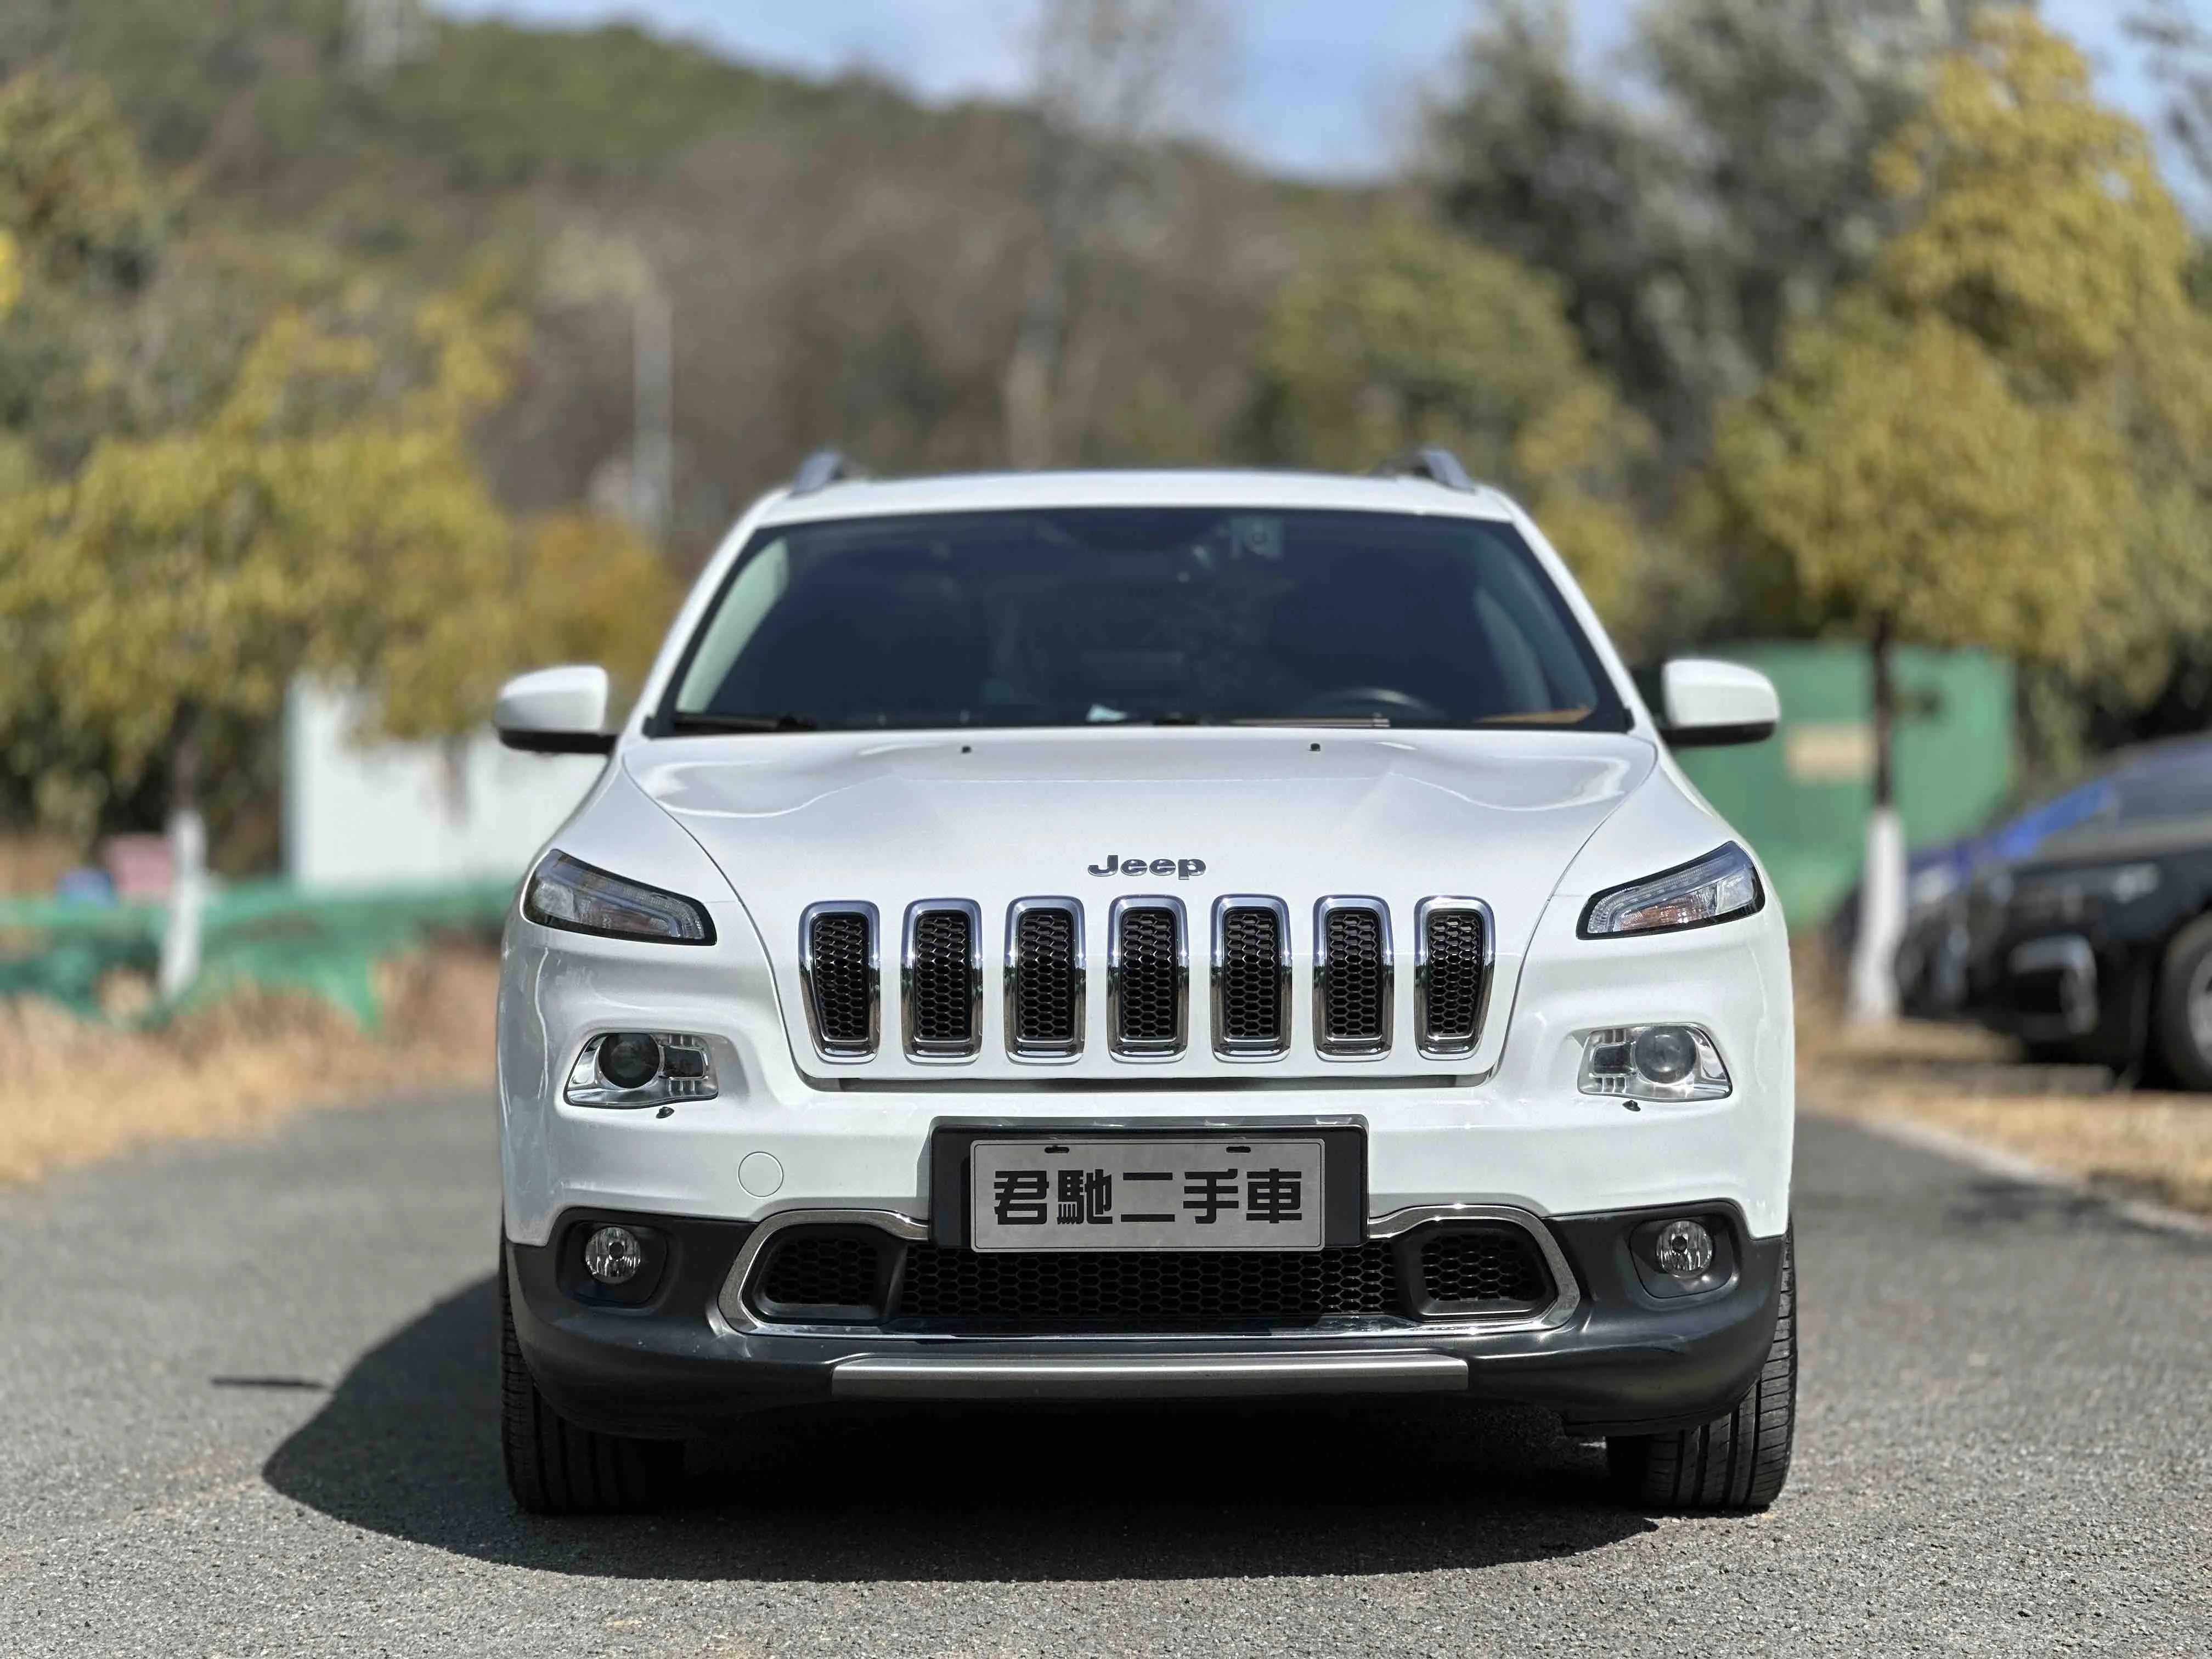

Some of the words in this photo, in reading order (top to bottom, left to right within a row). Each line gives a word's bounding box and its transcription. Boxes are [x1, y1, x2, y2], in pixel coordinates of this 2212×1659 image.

[1087, 855, 1206, 881] Jeep
[994, 1168, 1302, 1225] 君馳二手車
